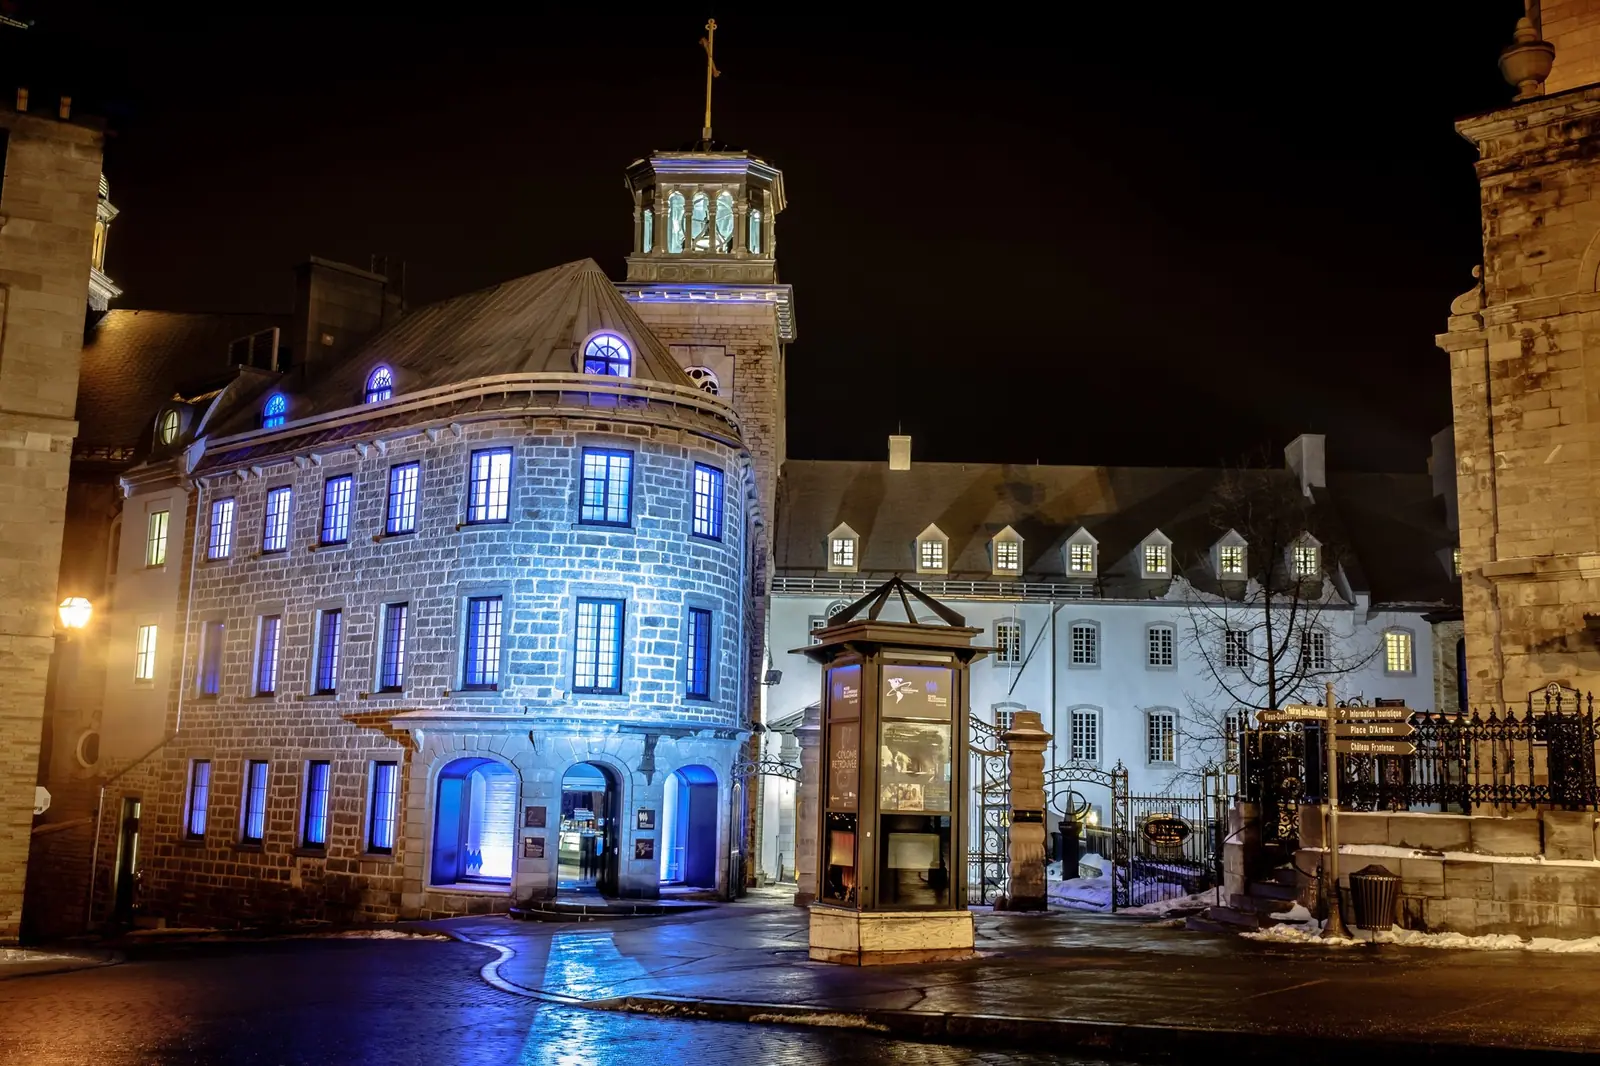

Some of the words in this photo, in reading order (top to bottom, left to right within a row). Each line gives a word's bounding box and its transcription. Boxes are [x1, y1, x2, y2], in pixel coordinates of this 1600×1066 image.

[1349, 709, 1375, 718] Information
[1377, 709, 1402, 719] touristique
[1350, 725, 1367, 734] Place
[1369, 725, 1394, 734] D'Armes
[1350, 742, 1370, 751] Château
[1371, 742, 1395, 752] Frontenac
